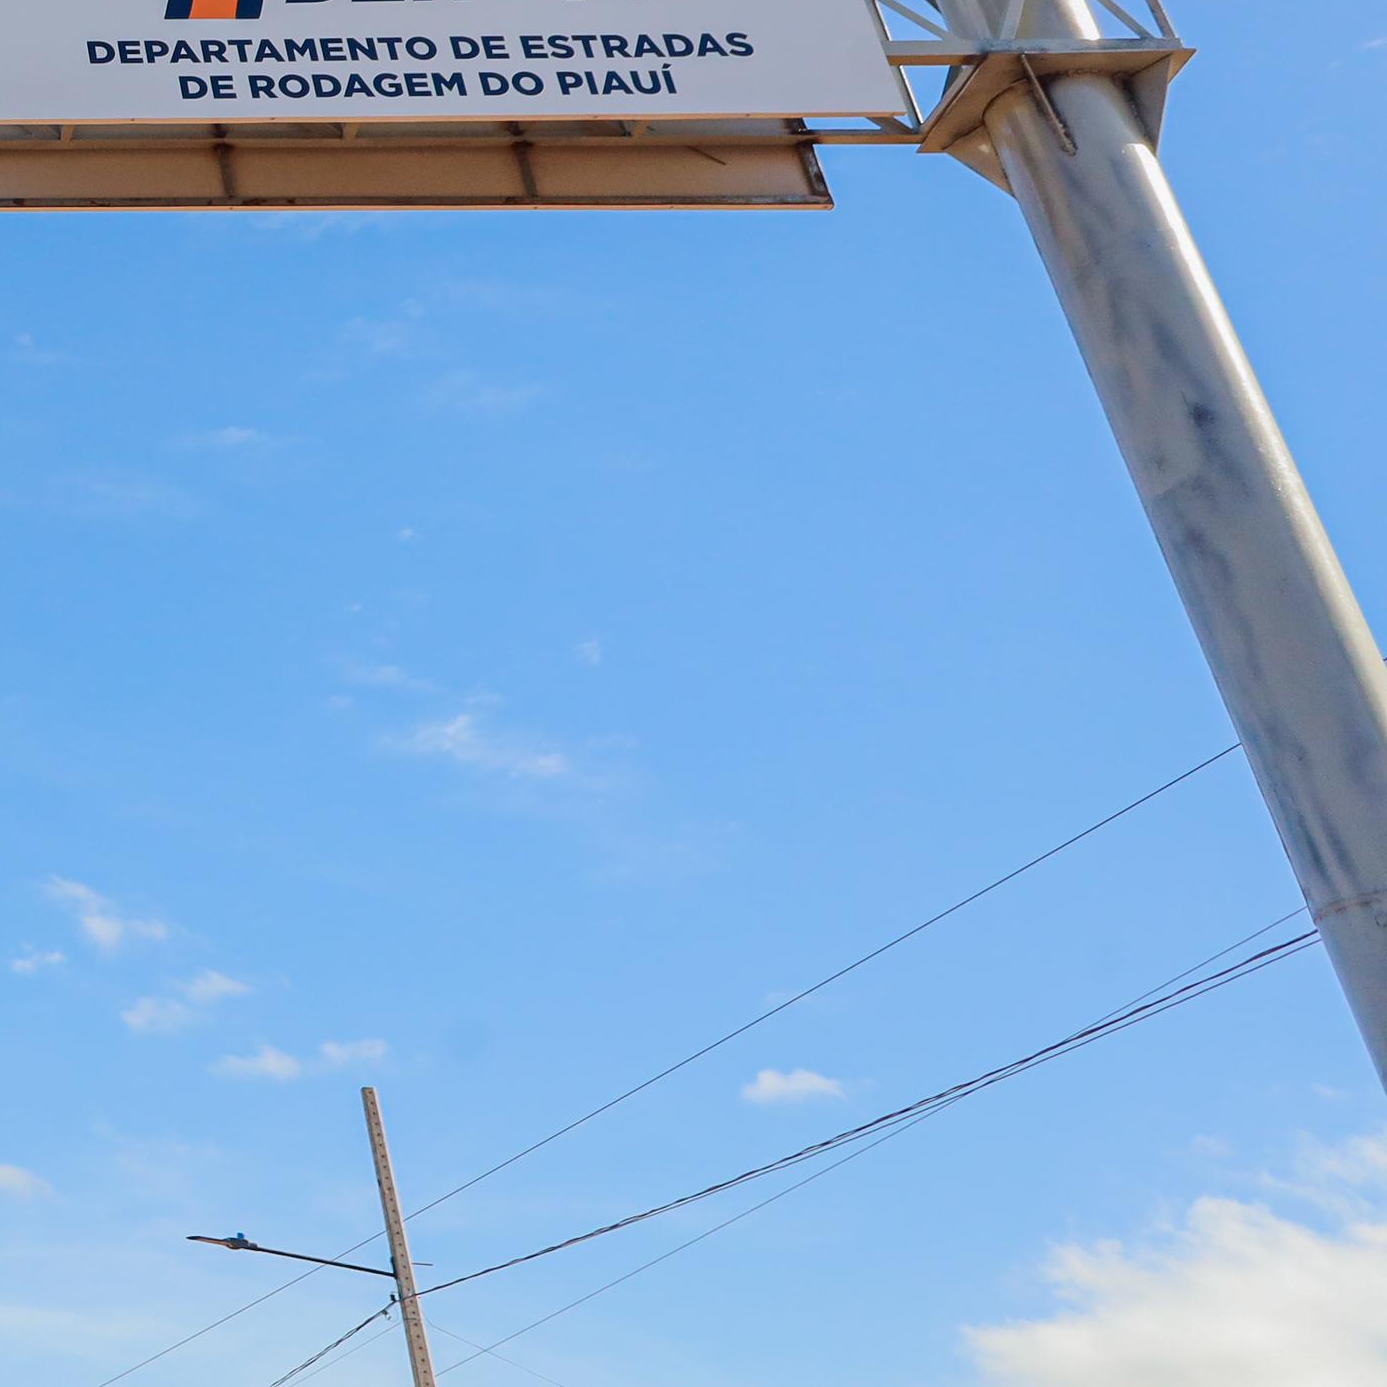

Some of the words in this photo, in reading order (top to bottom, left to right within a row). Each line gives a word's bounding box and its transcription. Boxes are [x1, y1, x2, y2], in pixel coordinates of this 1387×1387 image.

[87, 37, 437, 64] DEPARTAMENTO
[449, 36, 510, 59] DE
[519, 33, 754, 59] ESTRADAS
[179, 75, 237, 99] DE
[248, 72, 467, 98] RODAGEM
[478, 72, 544, 96] DO
[556, 63, 677, 95] PIAUÍ
